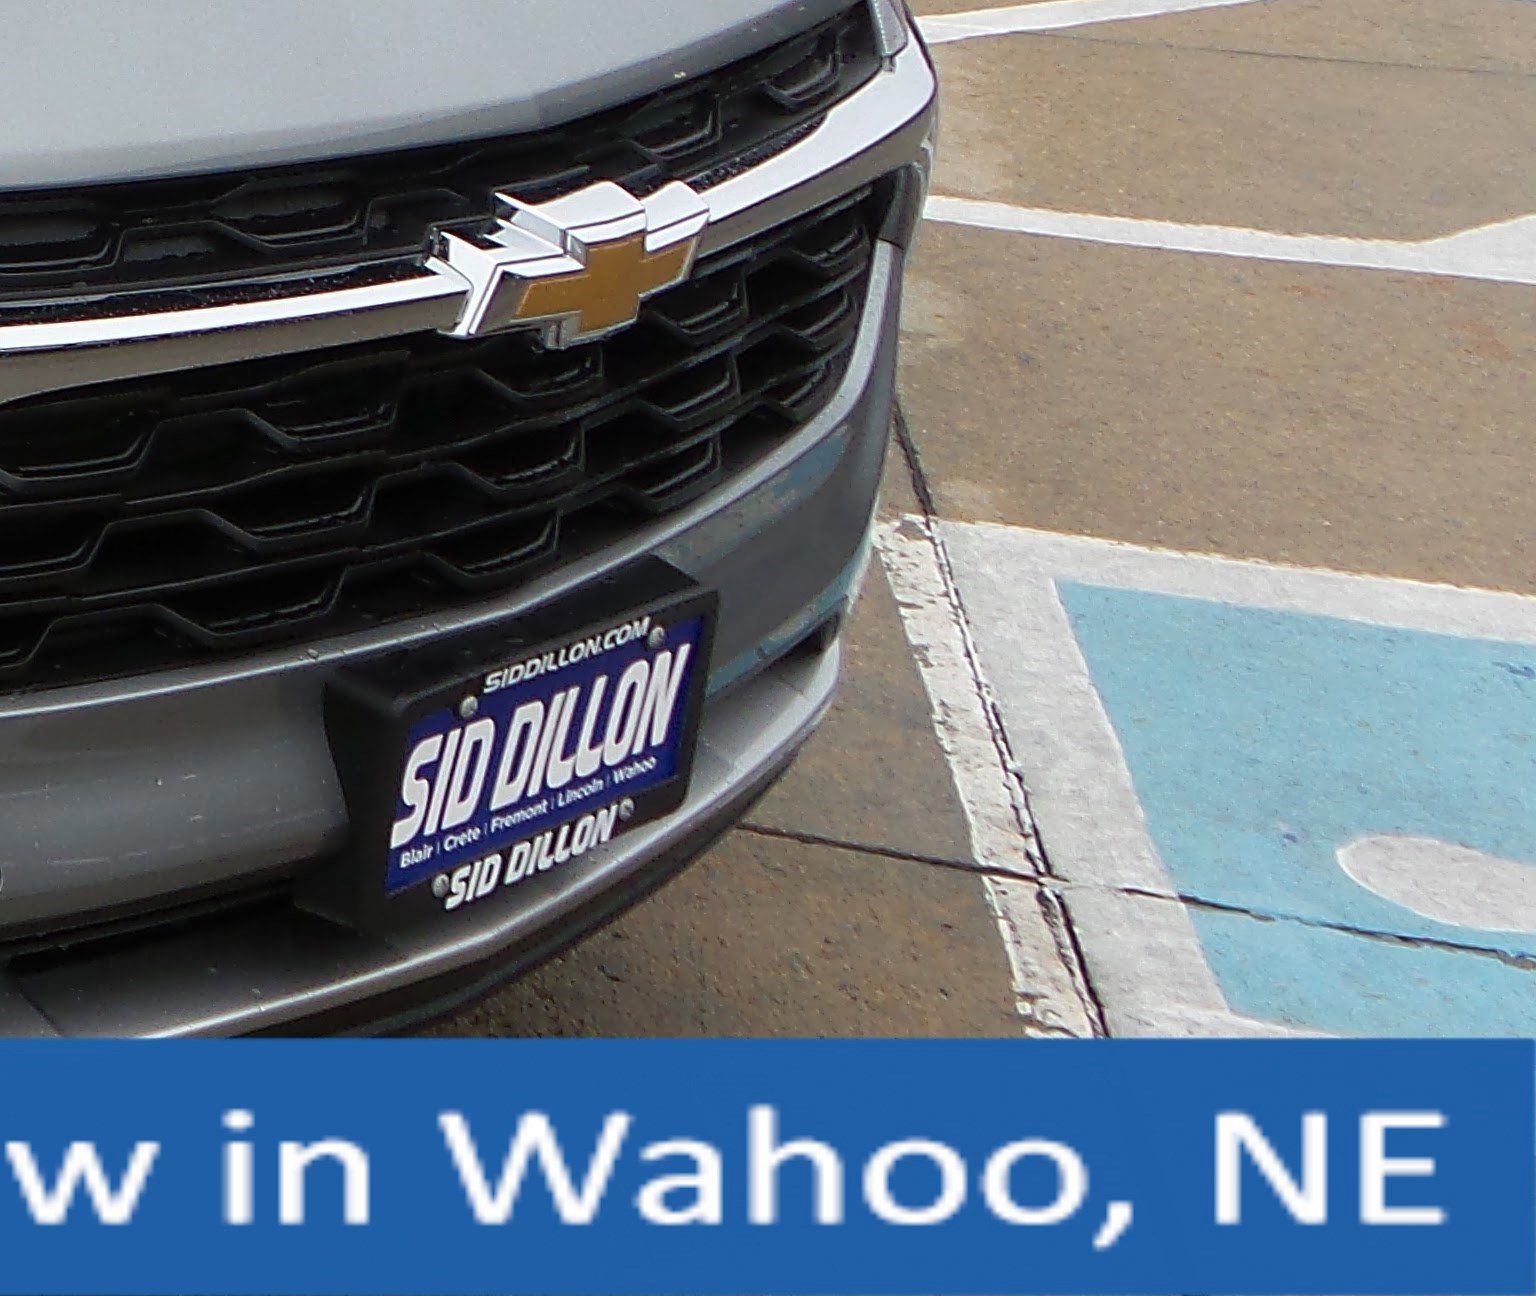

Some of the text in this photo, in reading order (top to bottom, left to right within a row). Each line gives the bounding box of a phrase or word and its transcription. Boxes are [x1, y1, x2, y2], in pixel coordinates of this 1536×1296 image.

[483, 616, 650, 694] SIDDILLON.COM
[390, 643, 691, 849] SID DILLON
[400, 756, 657, 868] Blair Crete Fremont Lincoln Wahoo
[445, 804, 619, 910] SID DILLON
